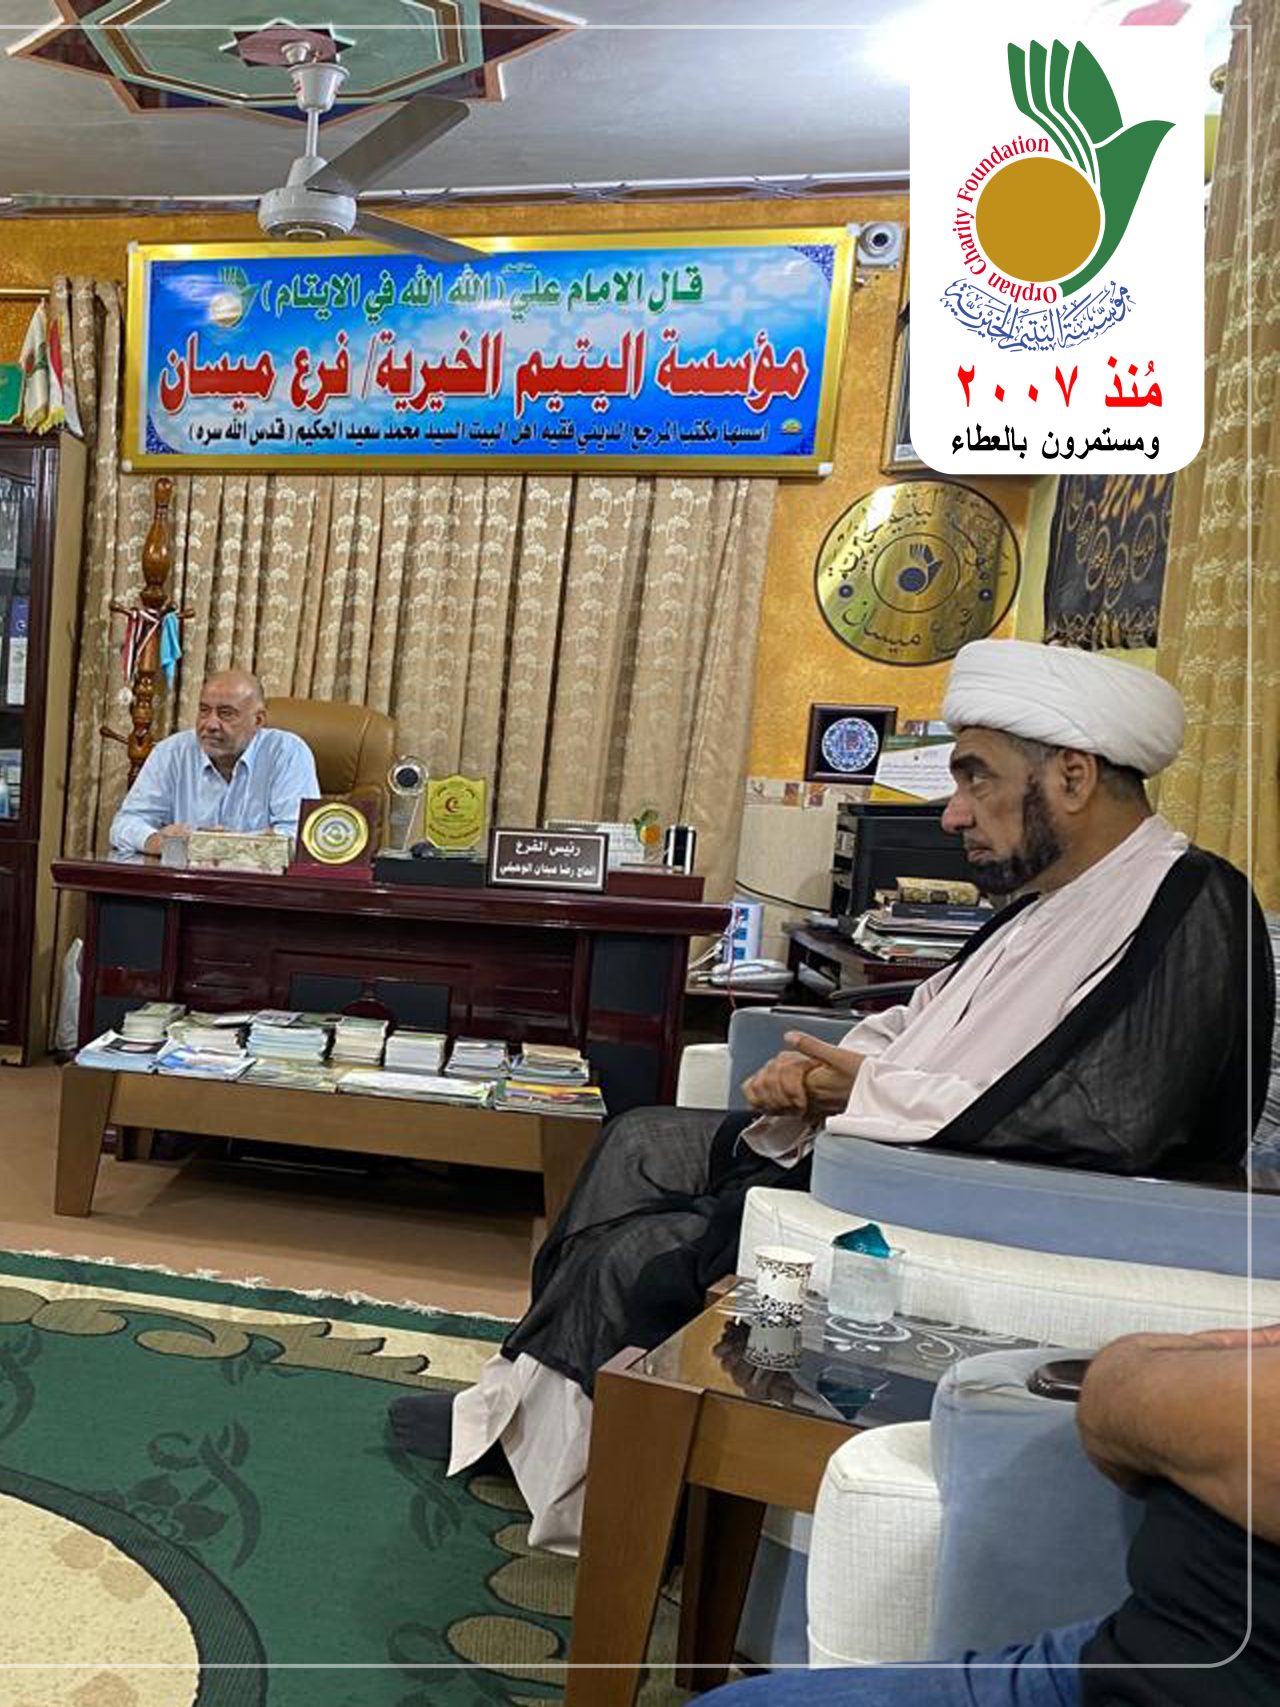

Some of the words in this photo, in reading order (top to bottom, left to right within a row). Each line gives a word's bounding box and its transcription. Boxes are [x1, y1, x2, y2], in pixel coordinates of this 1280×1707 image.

[363, 270, 395, 323] في
[400, 264, 443, 306] الله
[567, 268, 642, 311] الامام
[647, 264, 704, 314] قال
[160, 332, 277, 414] ميسان
[291, 329, 350, 412] فرع
[515, 330, 646, 419] اليتيم
[655, 329, 808, 413] مؤسسة
[224, 418, 248, 441] الله
[295, 418, 343, 446] الحكيم
[345, 420, 381, 447] سعيد
[424, 421, 465, 447] السيد
[679, 416, 719, 447] مكتب
[515, 838, 549, 855] الفرع
[549, 840, 582, 857] رئيس
